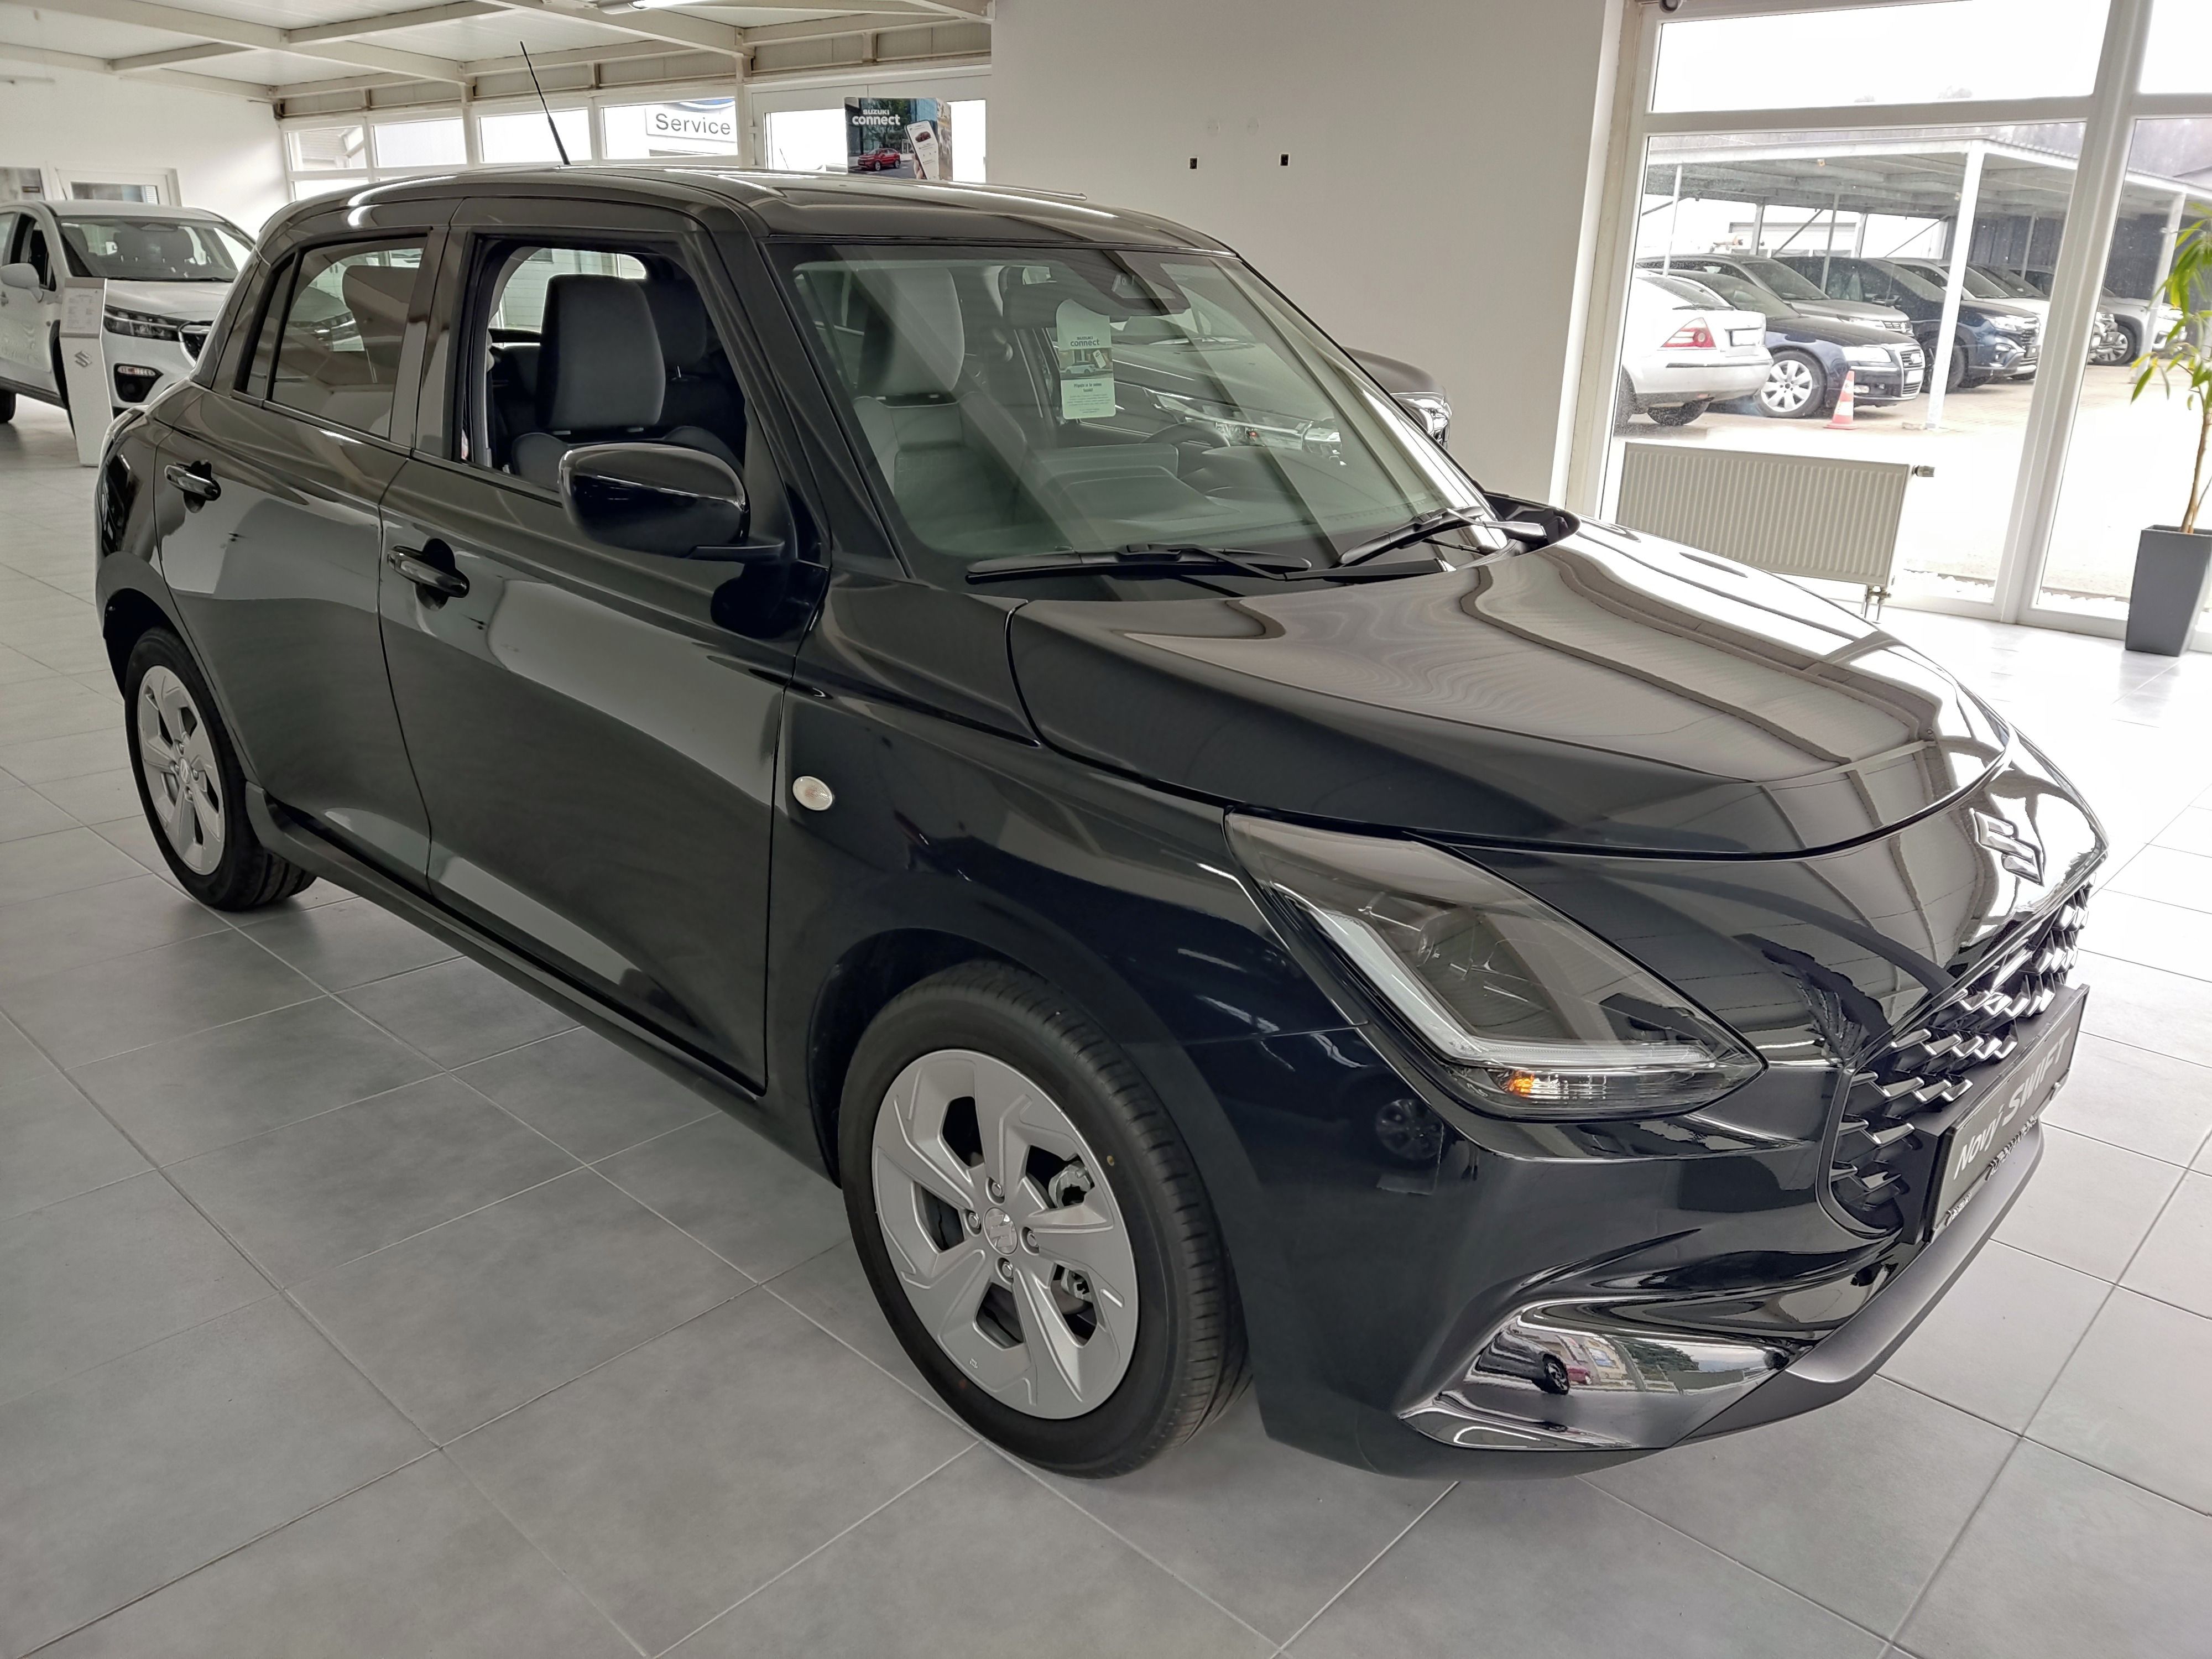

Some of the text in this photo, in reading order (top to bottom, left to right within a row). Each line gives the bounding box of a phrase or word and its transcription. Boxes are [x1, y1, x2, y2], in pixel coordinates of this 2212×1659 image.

[655, 113, 731, 135] Service
[852, 114, 901, 126] connect
[1070, 338, 1100, 347] connect
[1953, 1103, 2005, 1181] Nový
[2001, 1027, 2072, 1126] SWIFT
